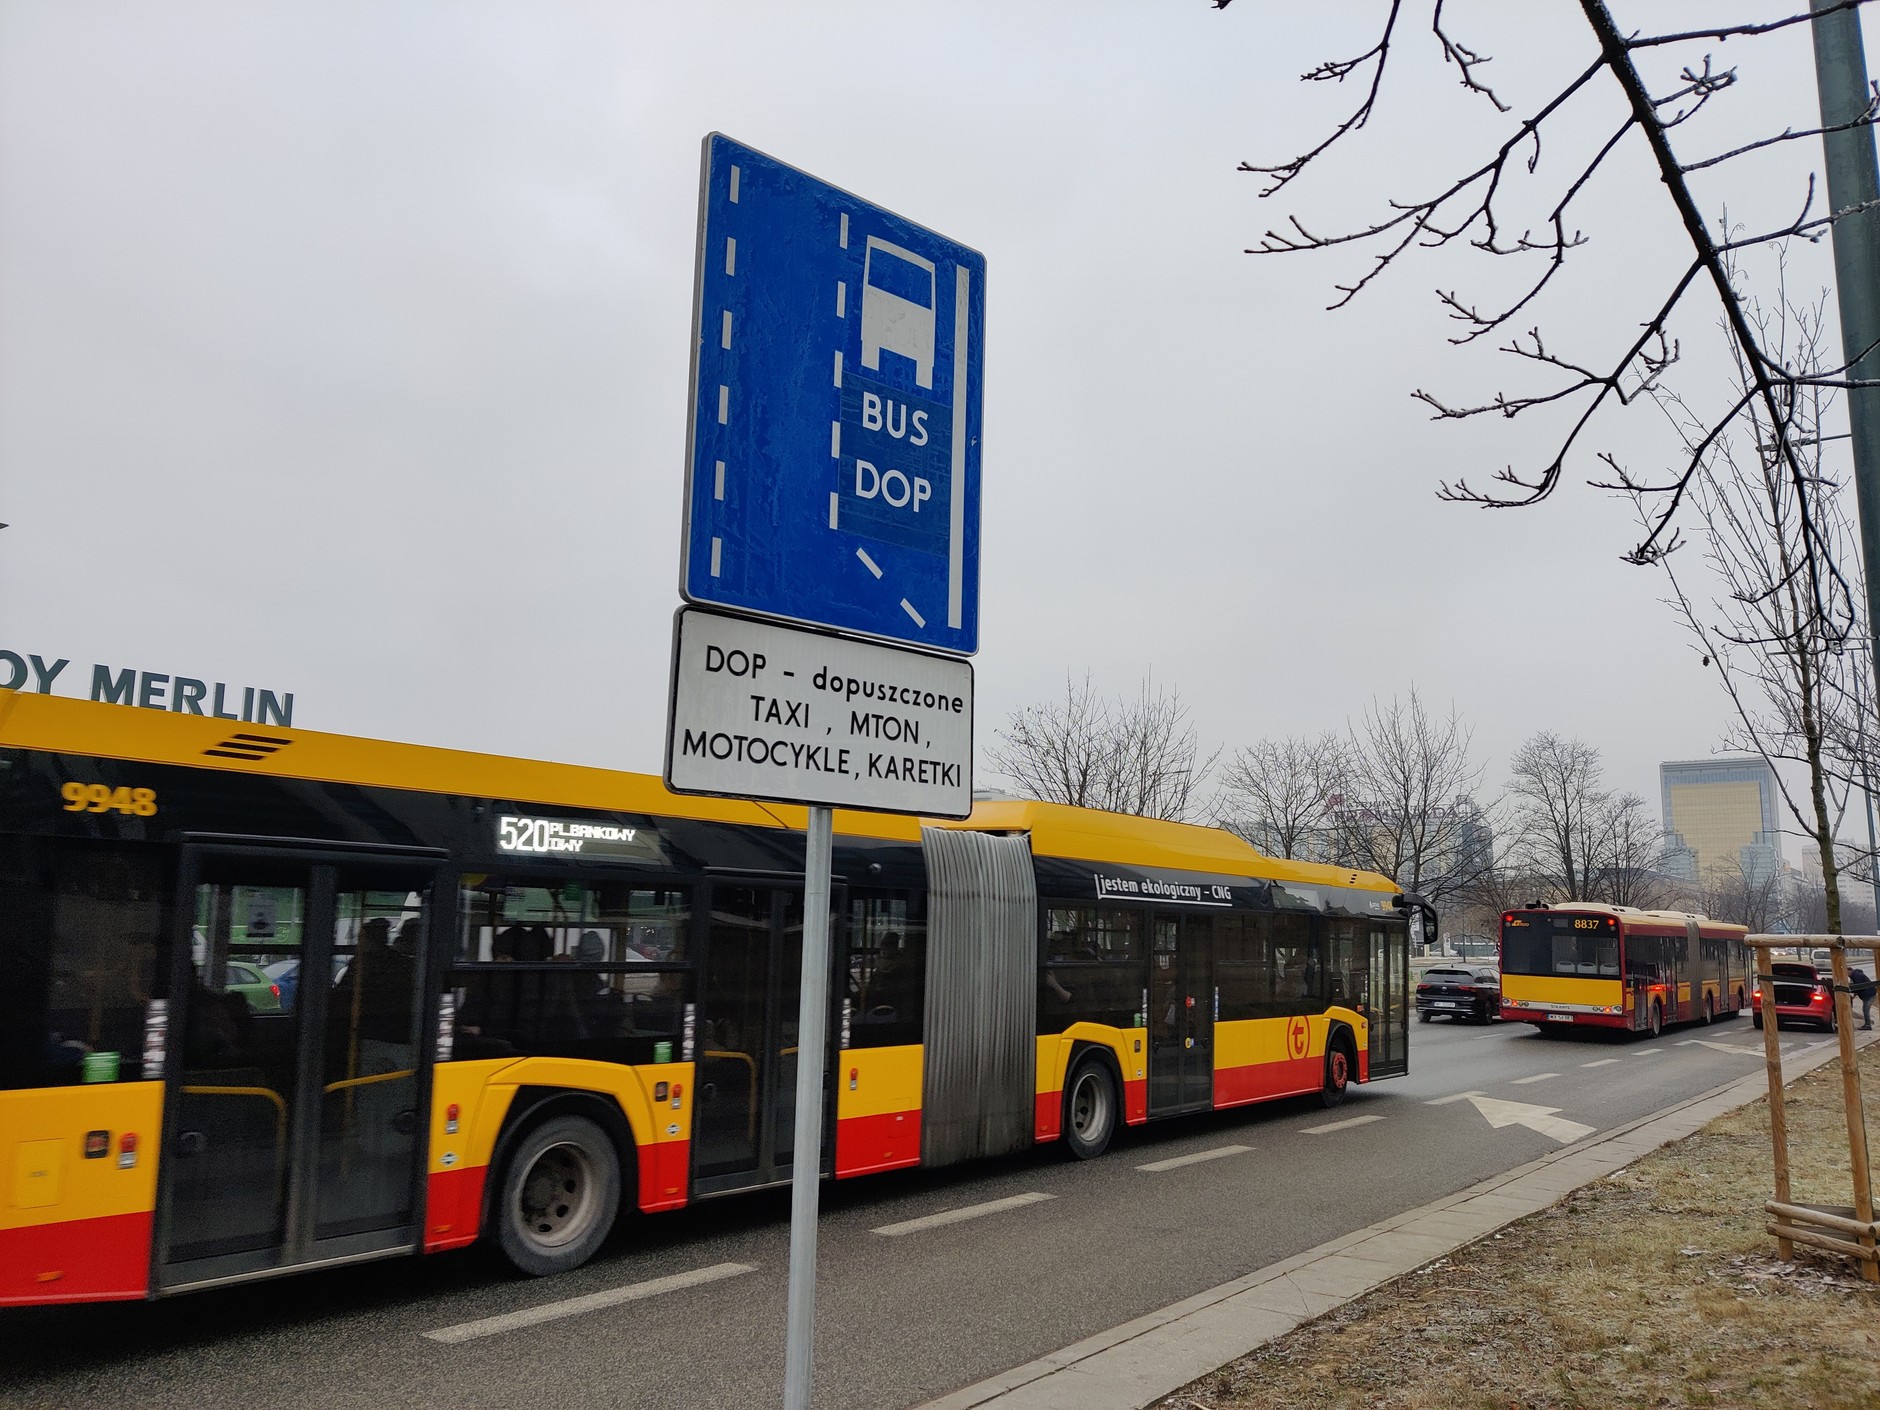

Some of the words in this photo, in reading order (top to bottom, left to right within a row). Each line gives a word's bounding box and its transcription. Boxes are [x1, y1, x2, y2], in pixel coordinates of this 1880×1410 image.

[861, 390, 929, 447] BUS
[855, 458, 932, 513] DOP
[89, 663, 294, 729] MERLIN
[705, 645, 767, 679] DOP
[812, 665, 964, 714] dopuszczone
[682, 728, 860, 781] MOTOCYKLE,
[868, 752, 962, 788] KARETKI
[60, 781, 159, 818] 9948
[500, 816, 550, 852] 520
[1100, 874, 1139, 894] jestem
[1141, 878, 1201, 901] ekologiczny
[1211, 885, 1232, 900] CNG
[1574, 919, 1600, 930] 8837
